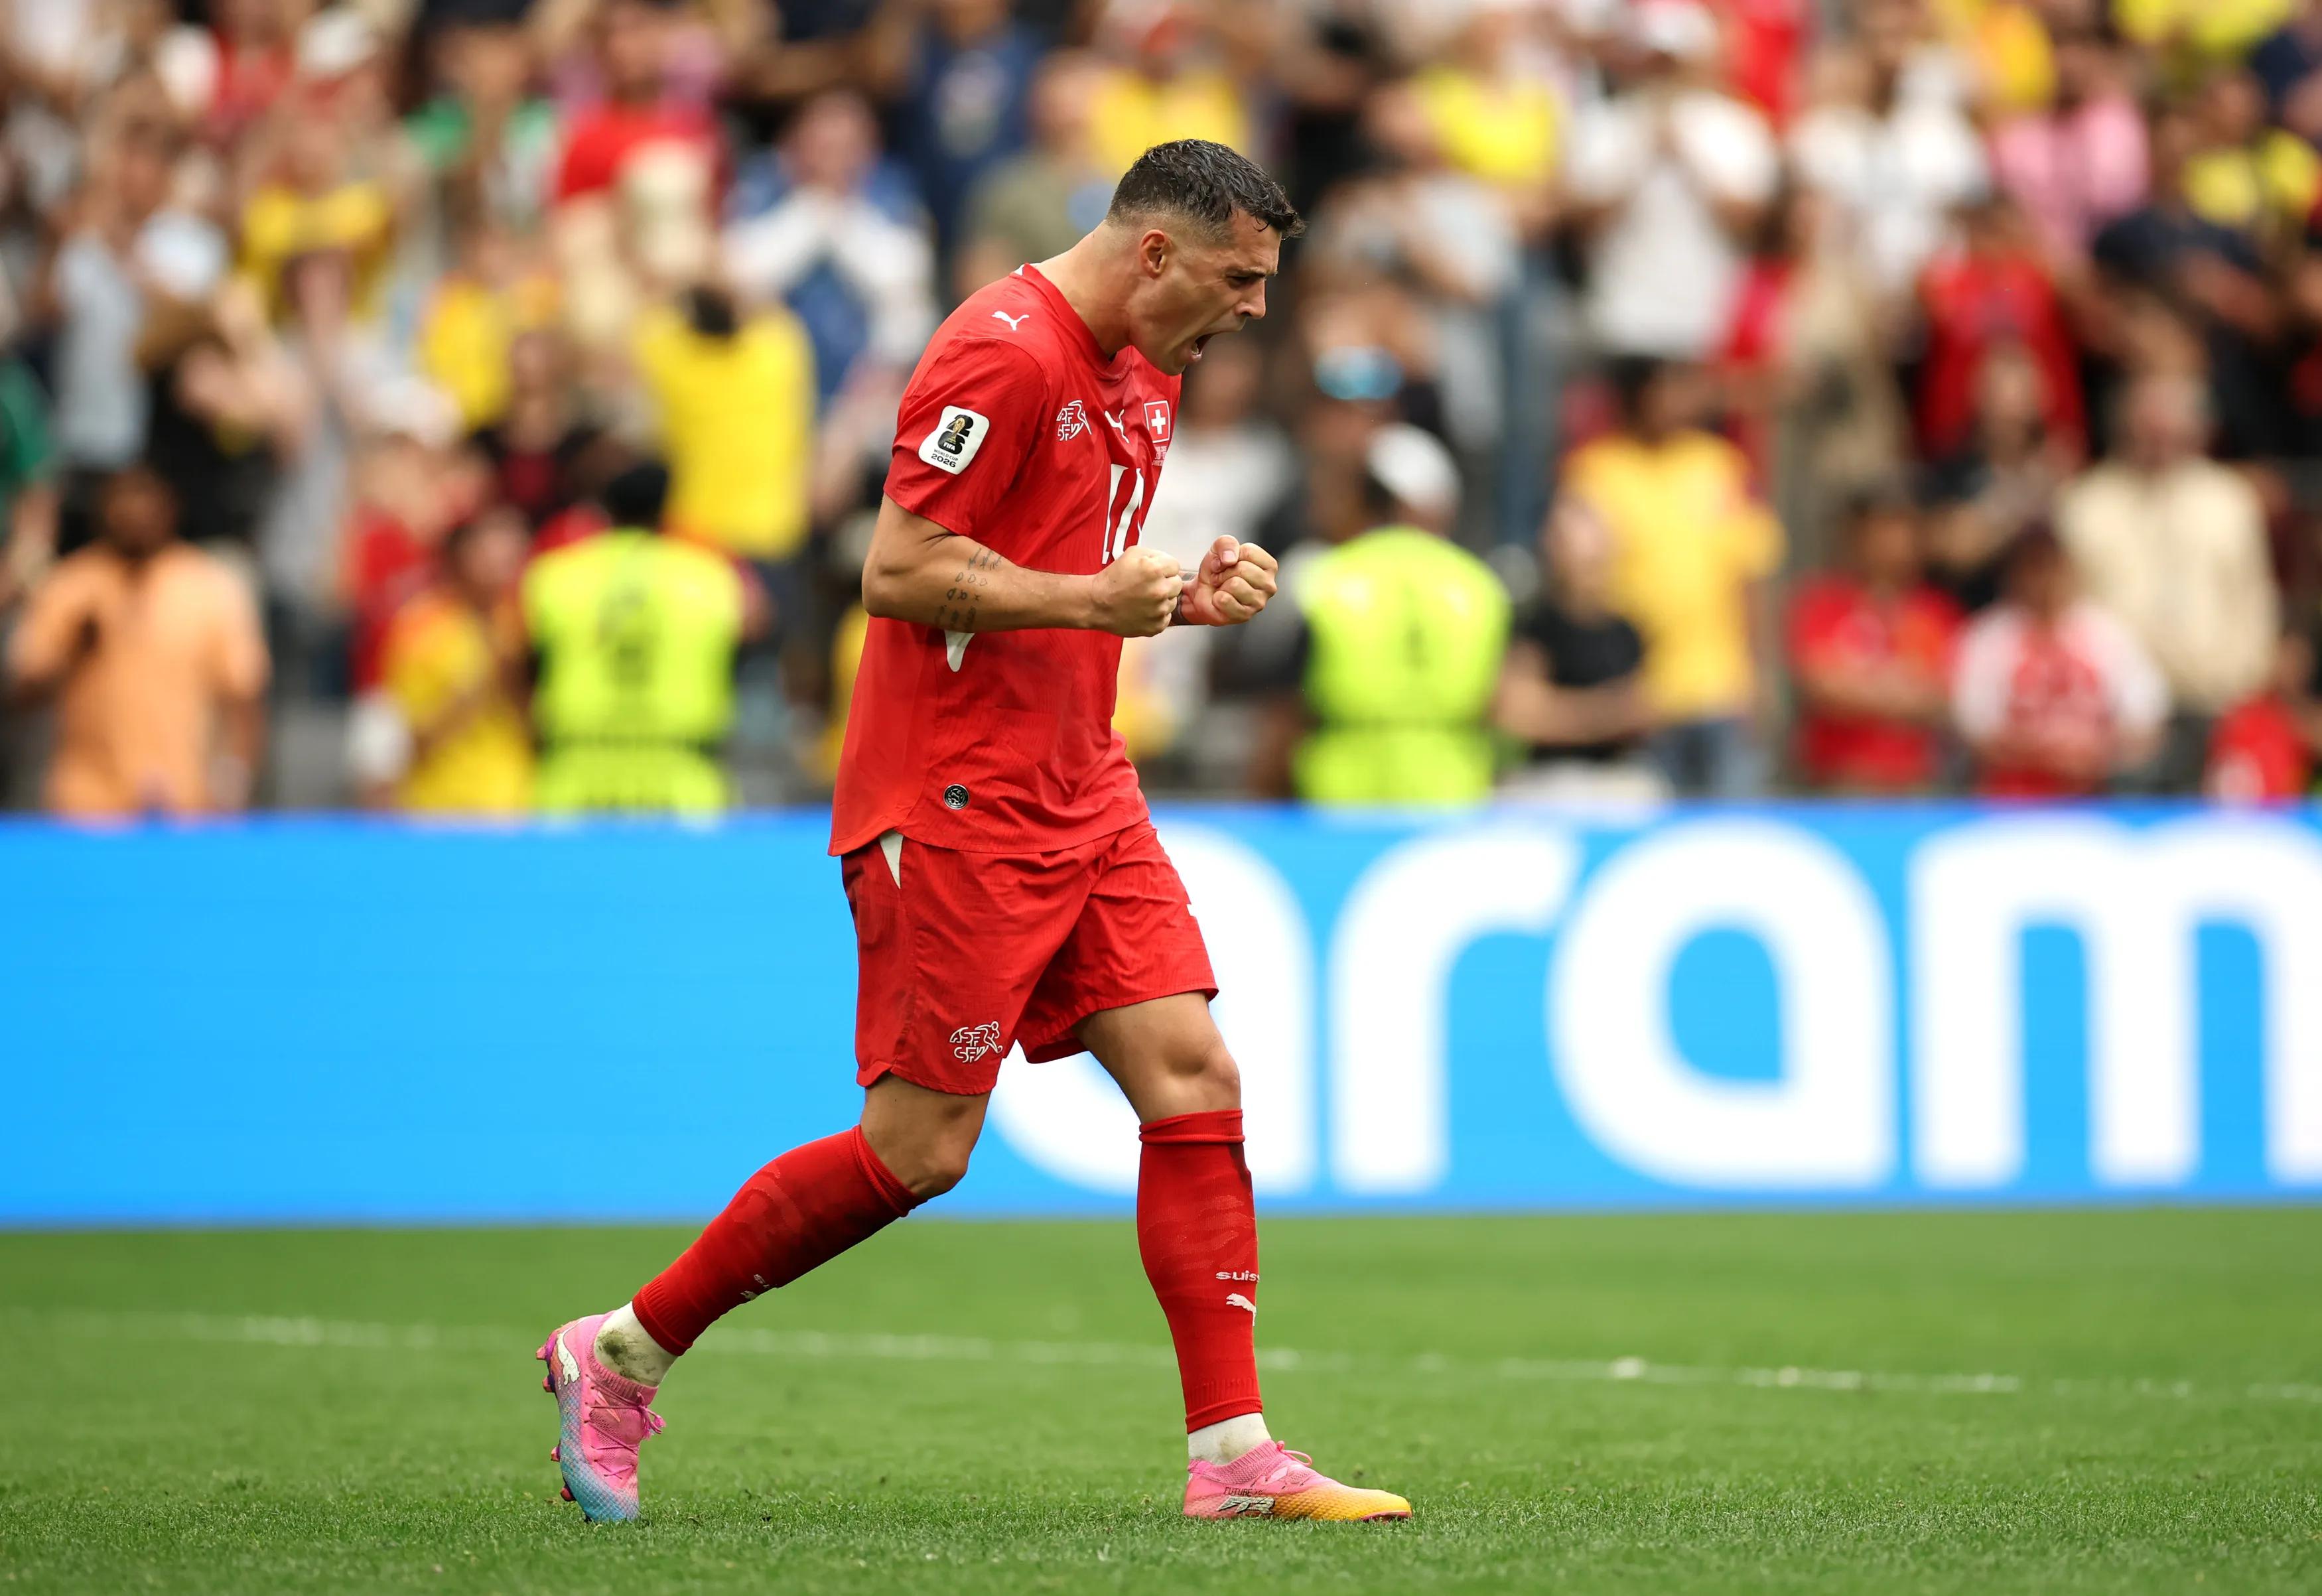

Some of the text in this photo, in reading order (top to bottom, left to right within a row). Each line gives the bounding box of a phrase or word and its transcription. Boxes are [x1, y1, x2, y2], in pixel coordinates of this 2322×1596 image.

[943, 442, 955, 451] FIFA
[934, 449, 949, 458] WORLD
[931, 454, 956, 468] 2026
[1223, 1487, 1253, 1497] FUTURE
